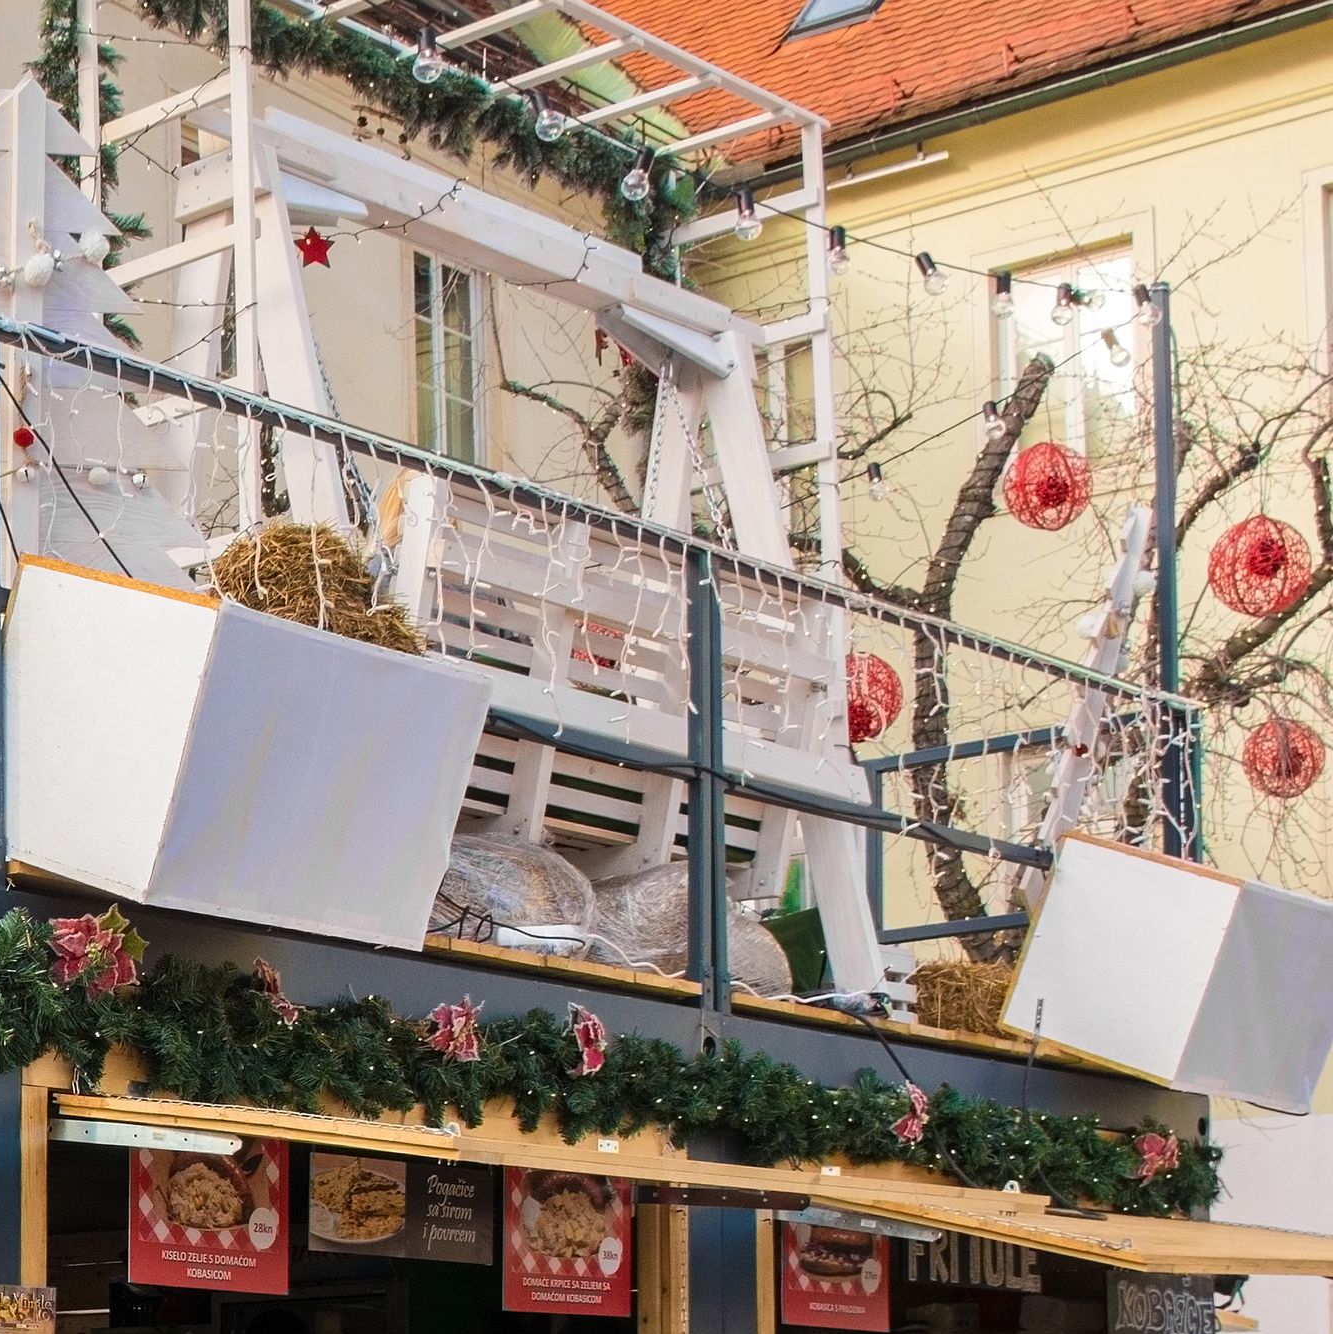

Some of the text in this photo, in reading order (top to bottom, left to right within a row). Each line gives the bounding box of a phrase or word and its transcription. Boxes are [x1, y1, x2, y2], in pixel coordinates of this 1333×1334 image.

[427, 1174, 475, 1206] Pogačice
[426, 1201, 472, 1220] sa sirom
[253, 1222, 273, 1234] 28kn
[422, 1222, 476, 1251] i povrćem
[161, 1250, 187, 1262] KISELO
[208, 1254, 214, 1264] S
[214, 1253, 257, 1267] DOMAĆOM
[186, 1267, 232, 1281] KOBASICOM
